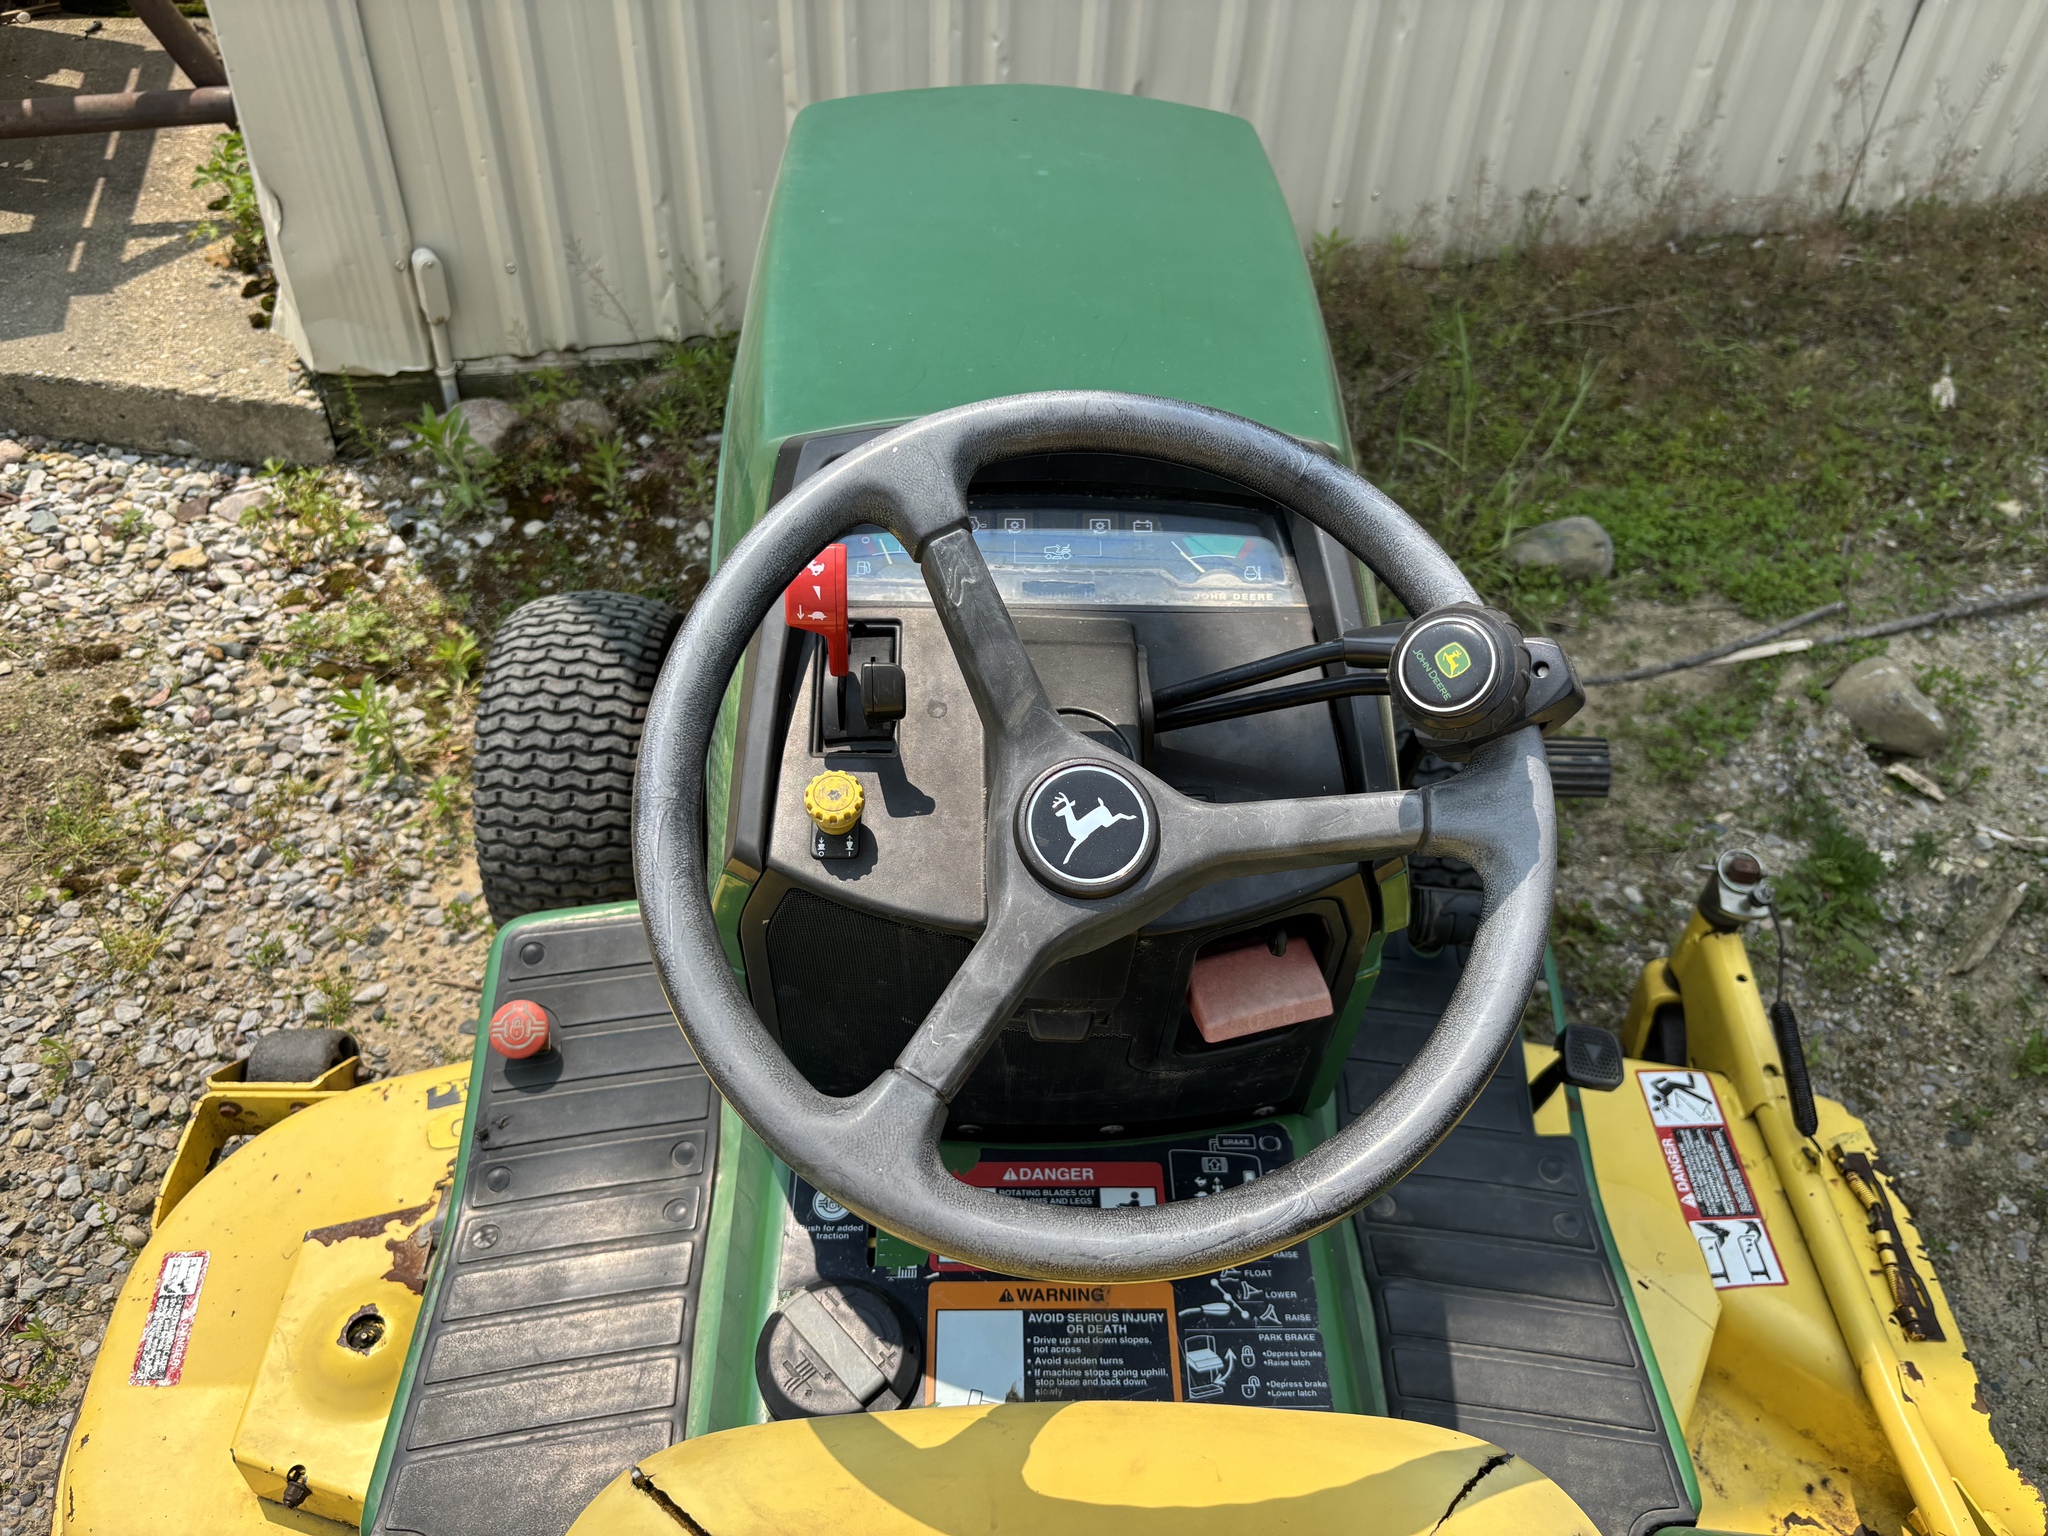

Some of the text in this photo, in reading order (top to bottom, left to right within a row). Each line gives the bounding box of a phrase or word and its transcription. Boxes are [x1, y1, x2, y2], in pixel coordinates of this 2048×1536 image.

[1232, 593, 1274, 601] DEERE
[1412, 649, 1451, 701] JOHN DEERE
[1222, 1138, 1250, 1146] BRAKE
[1661, 1138, 1691, 1192] DANGER
[1019, 1167, 1095, 1181] DANGER
[837, 1224, 864, 1232] added
[816, 1232, 850, 1240] traction
[1243, 1269, 1273, 1277] FLOAT
[1016, 1288, 1105, 1302] WARNING
[1265, 1291, 1297, 1299] LOWER
[1028, 1313, 1165, 1323] AVOID SERIOUS INJURY
[1066, 1324, 1128, 1334] OR DEATH
[1033, 1336, 1057, 1344] Drive
[1059, 1338, 1072, 1346] up
[1073, 1336, 1090, 1344] and
[1092, 1336, 1118, 1344] down
[1258, 1333, 1315, 1341] PARK BRAKE
[172, 1323, 188, 1367] DANGER
[1033, 1346, 1048, 1354] not
[1301, 1350, 1322, 1358] brake
[1034, 1357, 1124, 1365] Avoid sudden turns
[1034, 1368, 1169, 1378] If machine stops going uphill,
[1035, 1378, 1147, 1388] stop blade and back down
[1035, 1388, 1063, 1397] slowly
[1297, 1389, 1317, 1397] latch
